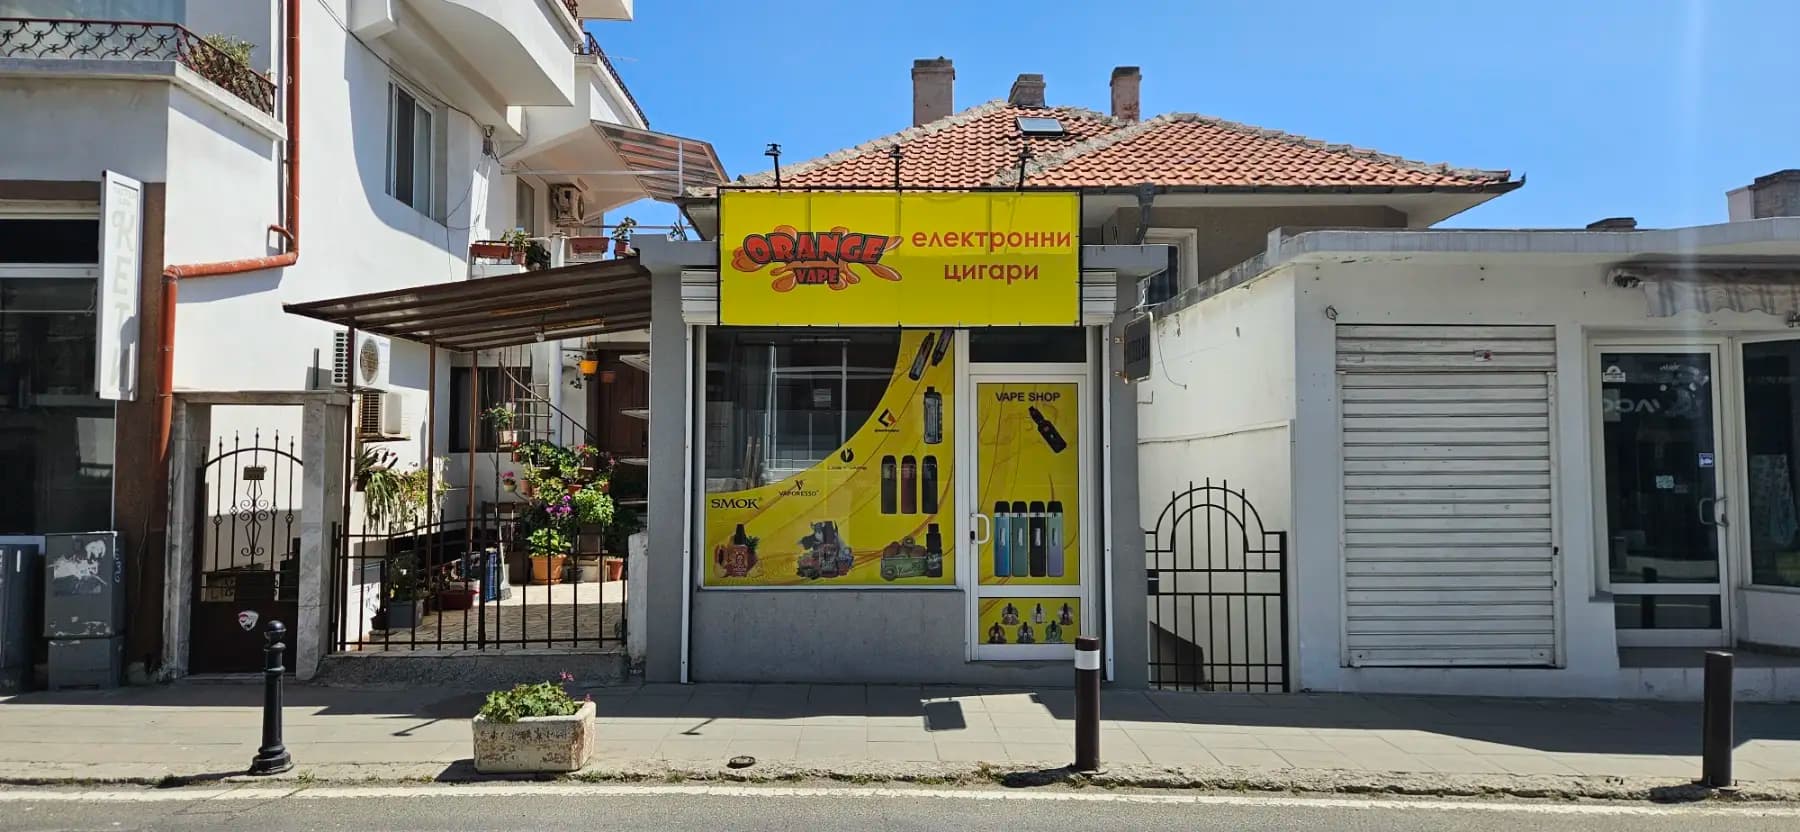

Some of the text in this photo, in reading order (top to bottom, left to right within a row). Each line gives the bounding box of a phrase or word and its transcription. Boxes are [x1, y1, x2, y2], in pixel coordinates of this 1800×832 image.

[743, 231, 889, 264] ORANGE
[911, 231, 1071, 252] електронни
[793, 266, 840, 285] VAPE
[944, 264, 1039, 285] цигари
[995, 392, 1061, 402] VAPE SHOP
[711, 498, 760, 510] SMOK
